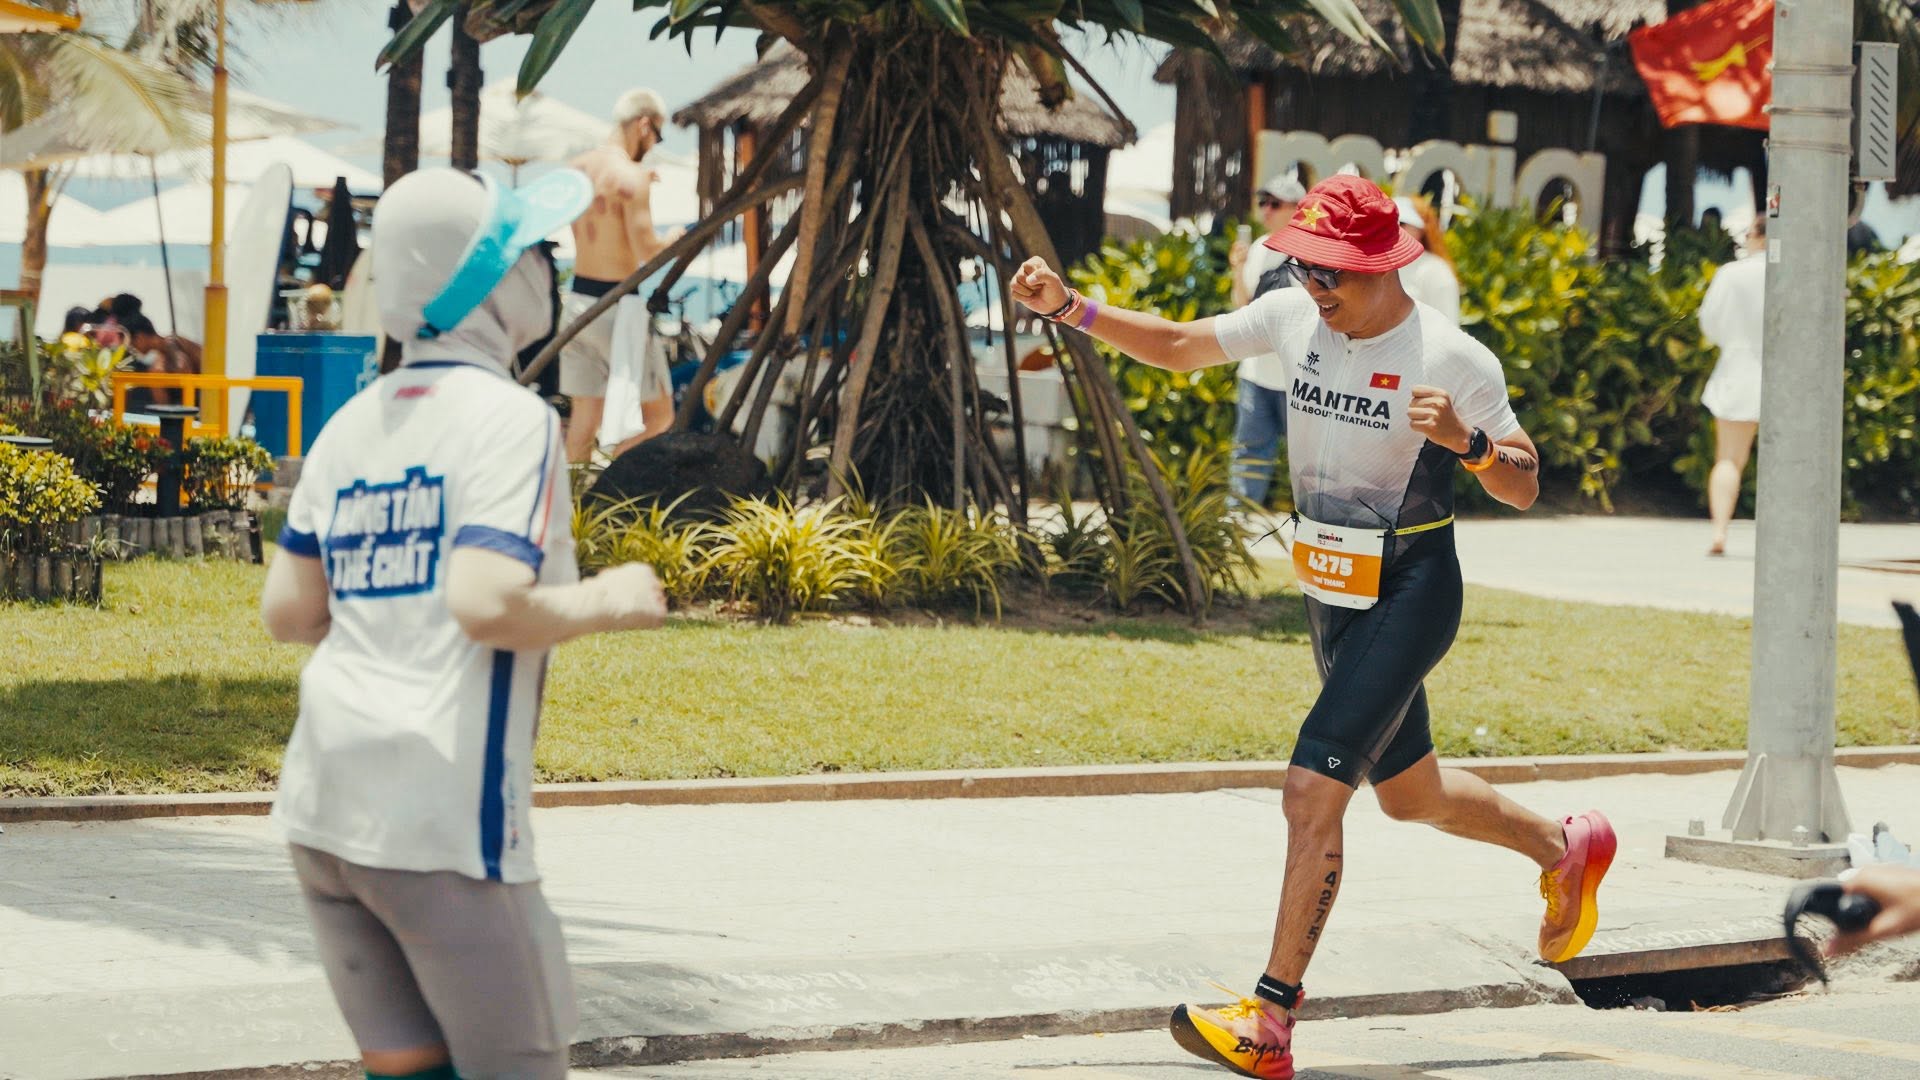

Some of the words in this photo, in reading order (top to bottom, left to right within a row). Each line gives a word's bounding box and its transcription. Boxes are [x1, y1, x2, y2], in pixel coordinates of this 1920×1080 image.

[1290, 400, 1300, 411] ALL
[1302, 404, 1332, 418] ABOUT
[1335, 413, 1390, 431] TRIATHLON
[1292, 377, 1391, 420] MANTRA
[1308, 551, 1353, 577] 4275
[1306, 871, 1337, 942] 4275
